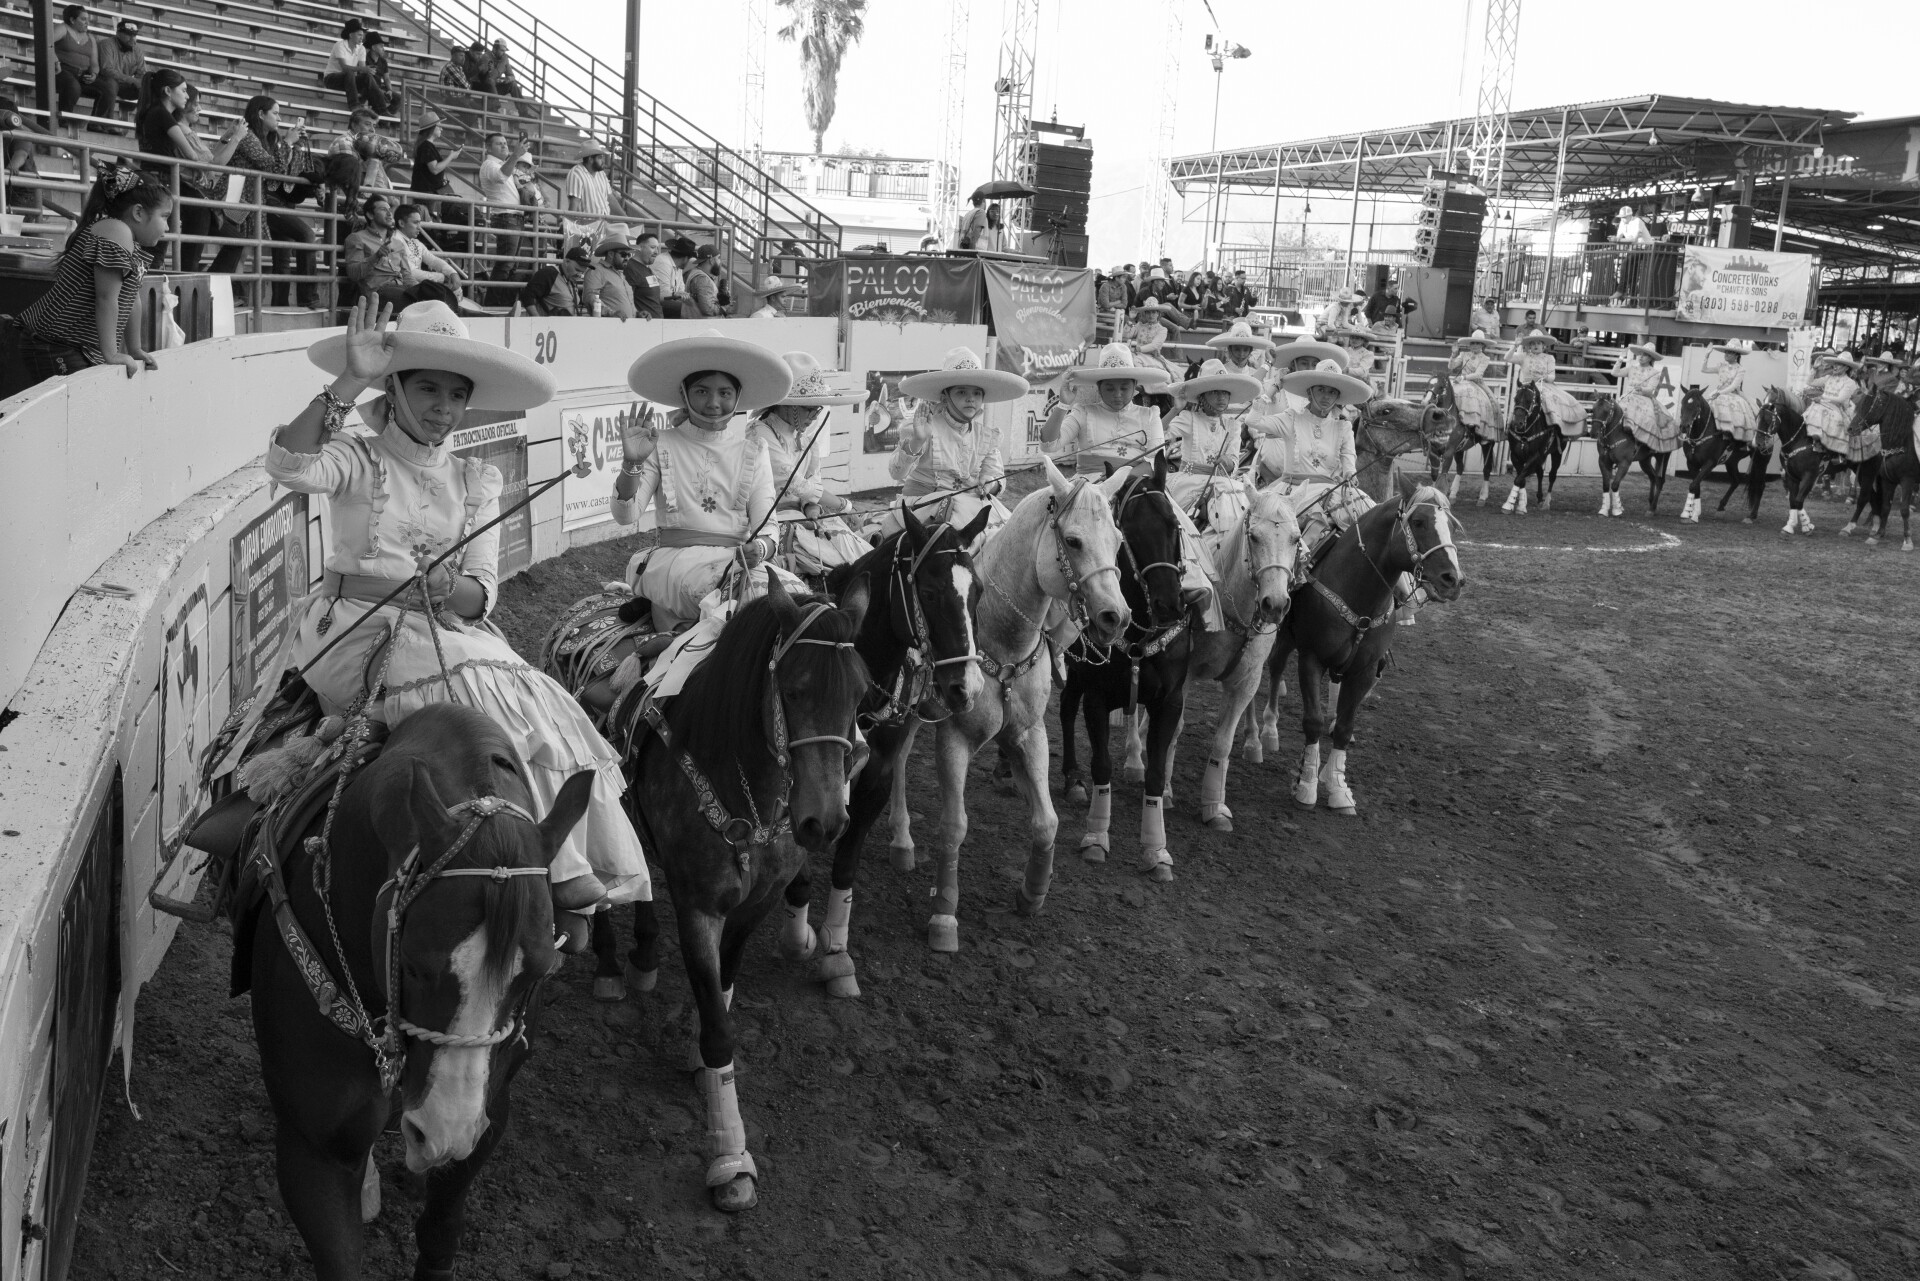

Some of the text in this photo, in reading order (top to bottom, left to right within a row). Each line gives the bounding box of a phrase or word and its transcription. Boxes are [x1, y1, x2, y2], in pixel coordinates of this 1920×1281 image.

[847, 265, 930, 295] PALCO
[1010, 273, 1064, 304] PALCO
[1721, 285, 1744, 295] CHAVEZ
[1745, 286, 1750, 295] &
[1751, 287, 1768, 296] SONS
[848, 297, 928, 318] Bienvenidos
[1015, 305, 1067, 324] Bienvenidos
[1700, 296, 1727, 311] (303)
[534, 330, 558, 365] 20
[453, 422, 518, 448] PATROCINADOR OFICIAL
[240, 501, 294, 573] DURAN EMBROIDERY
